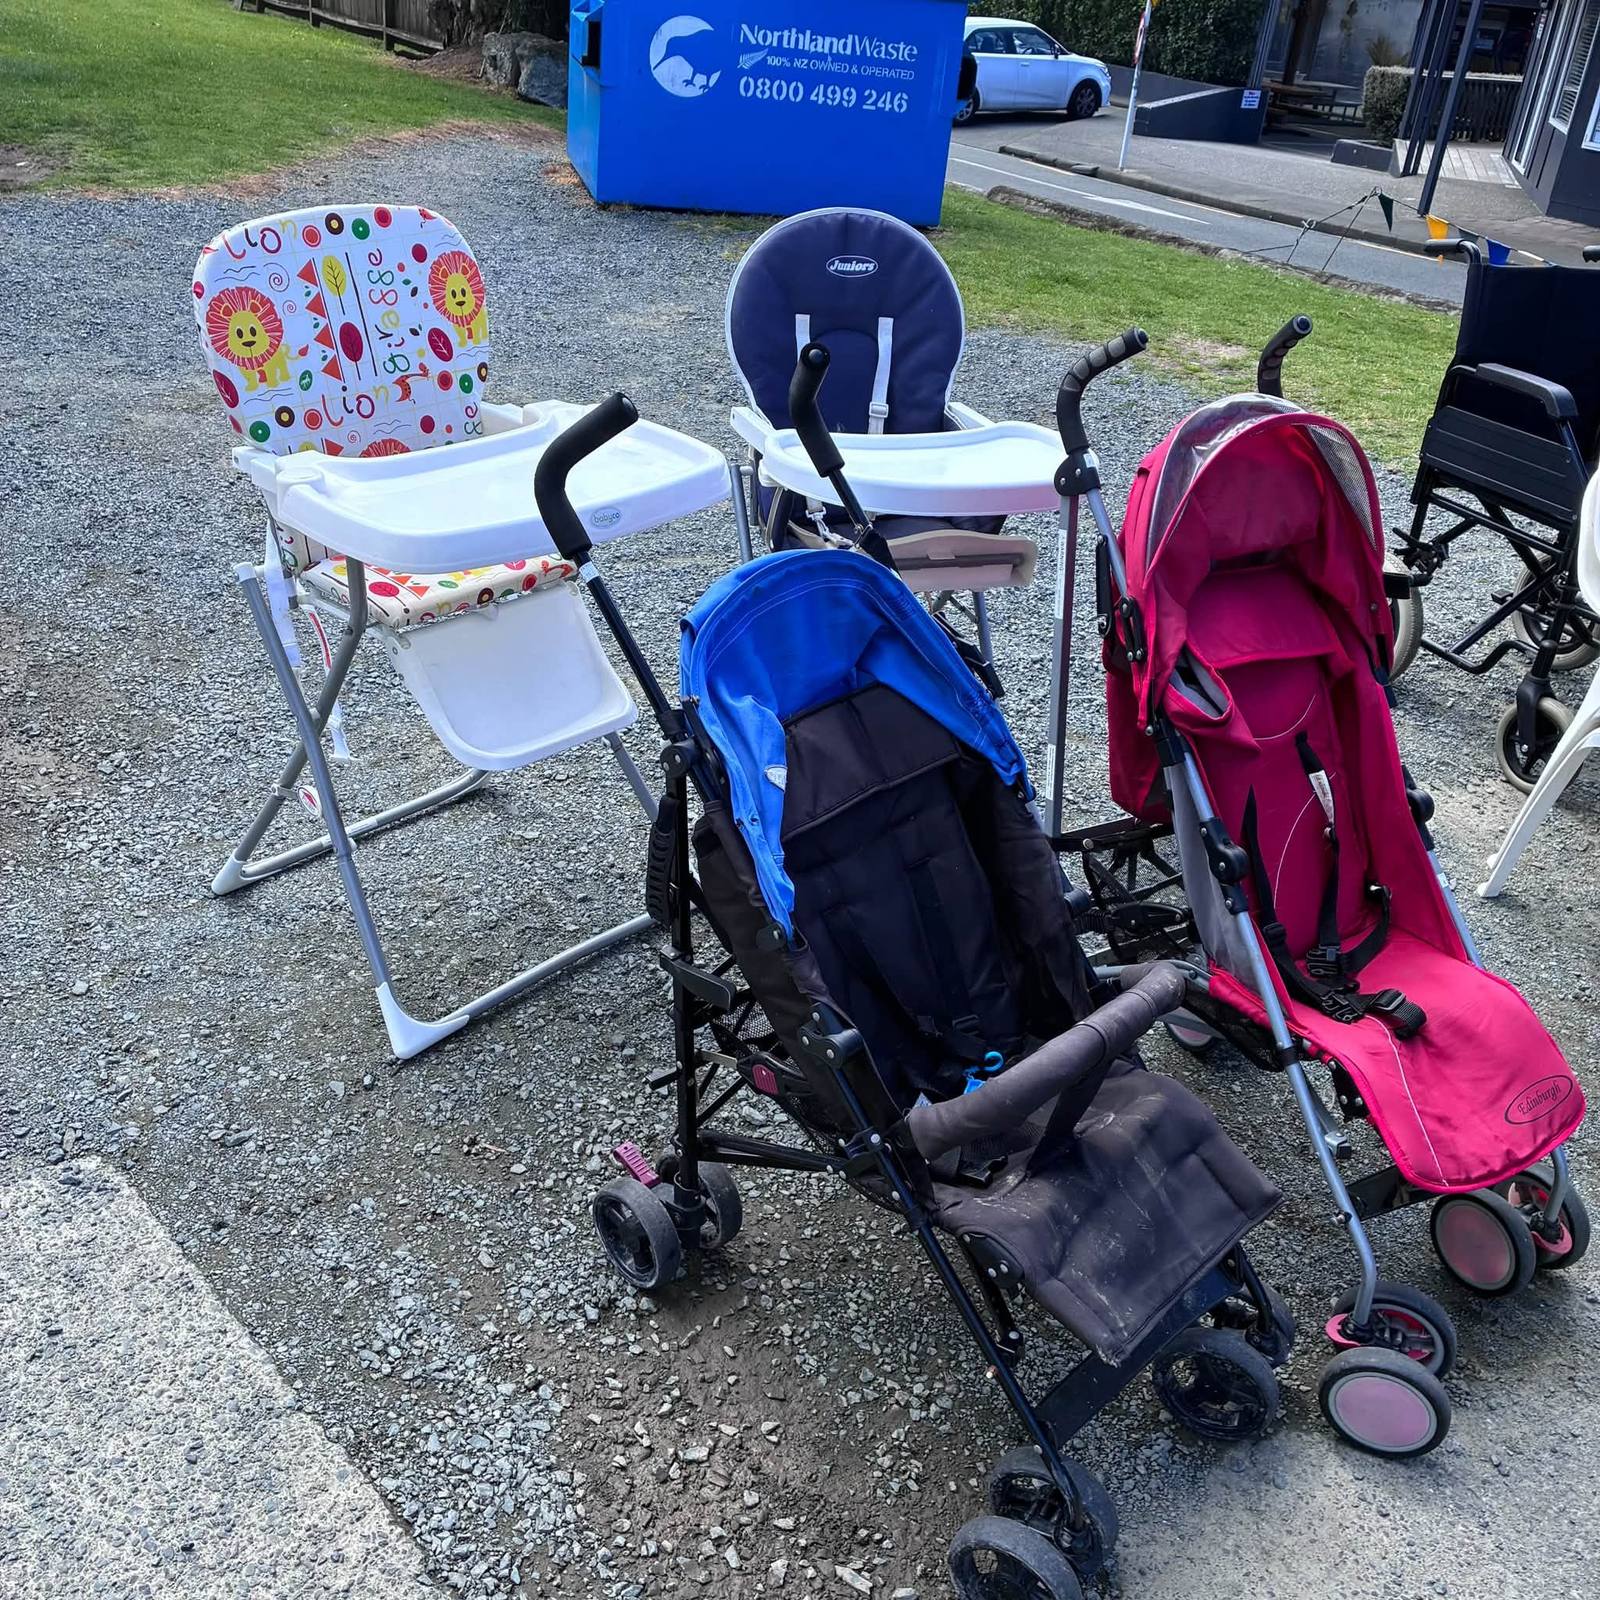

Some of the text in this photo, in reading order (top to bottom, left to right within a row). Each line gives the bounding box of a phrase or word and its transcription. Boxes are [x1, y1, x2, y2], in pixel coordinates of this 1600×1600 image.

[766, 55, 915, 81] 100% NZ OWNED & OPERATED
[739, 76, 909, 113] 0800 499 246
[829, 259, 875, 271] Juniors
[321, 384, 390, 427] lion
[1517, 1081, 1562, 1115] Edinburgh
